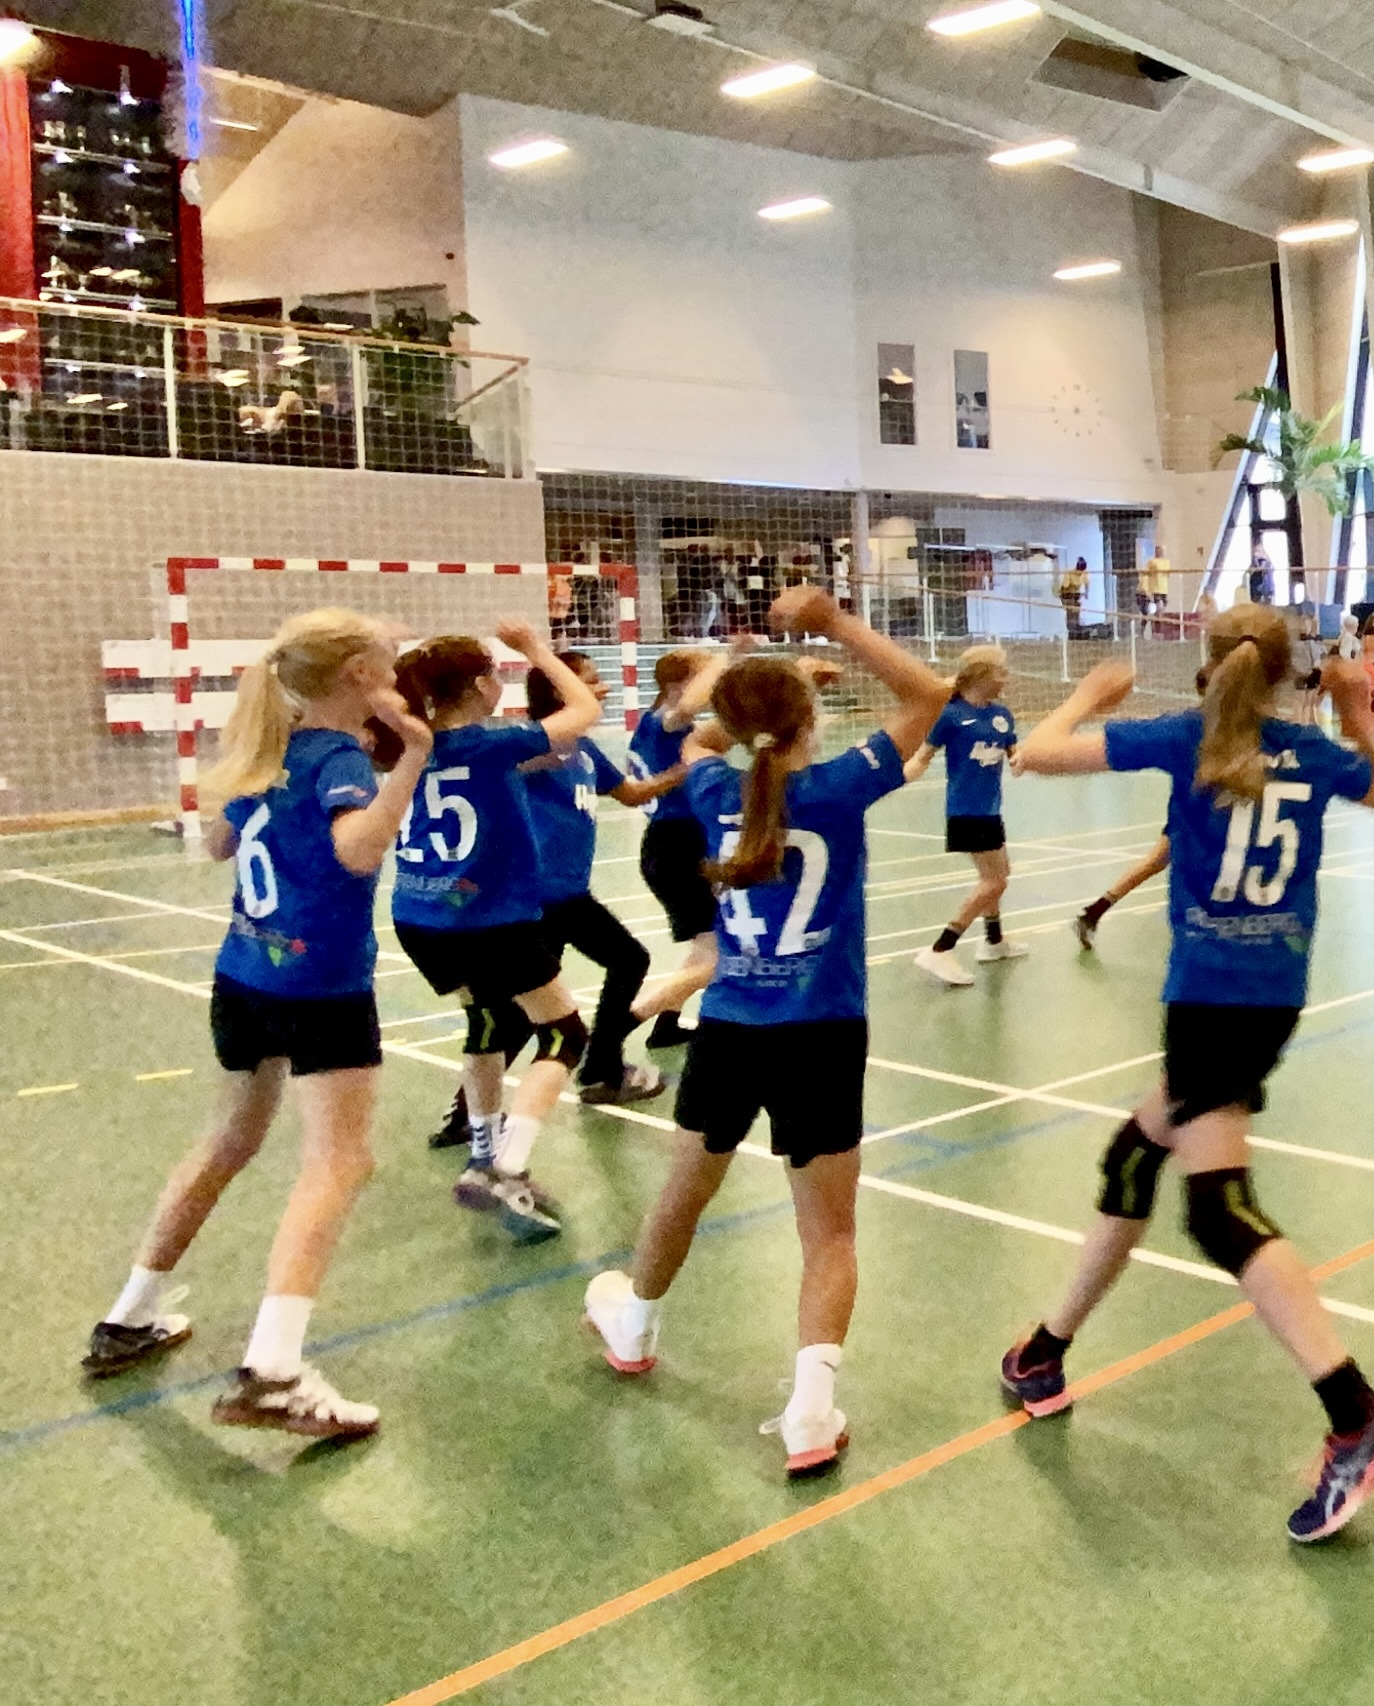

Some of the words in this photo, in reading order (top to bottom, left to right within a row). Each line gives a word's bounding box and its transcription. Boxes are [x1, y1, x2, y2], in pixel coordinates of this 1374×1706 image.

[236, 802, 279, 919] 6
[716, 829, 832, 957] 42
[1211, 782, 1312, 906] 15
